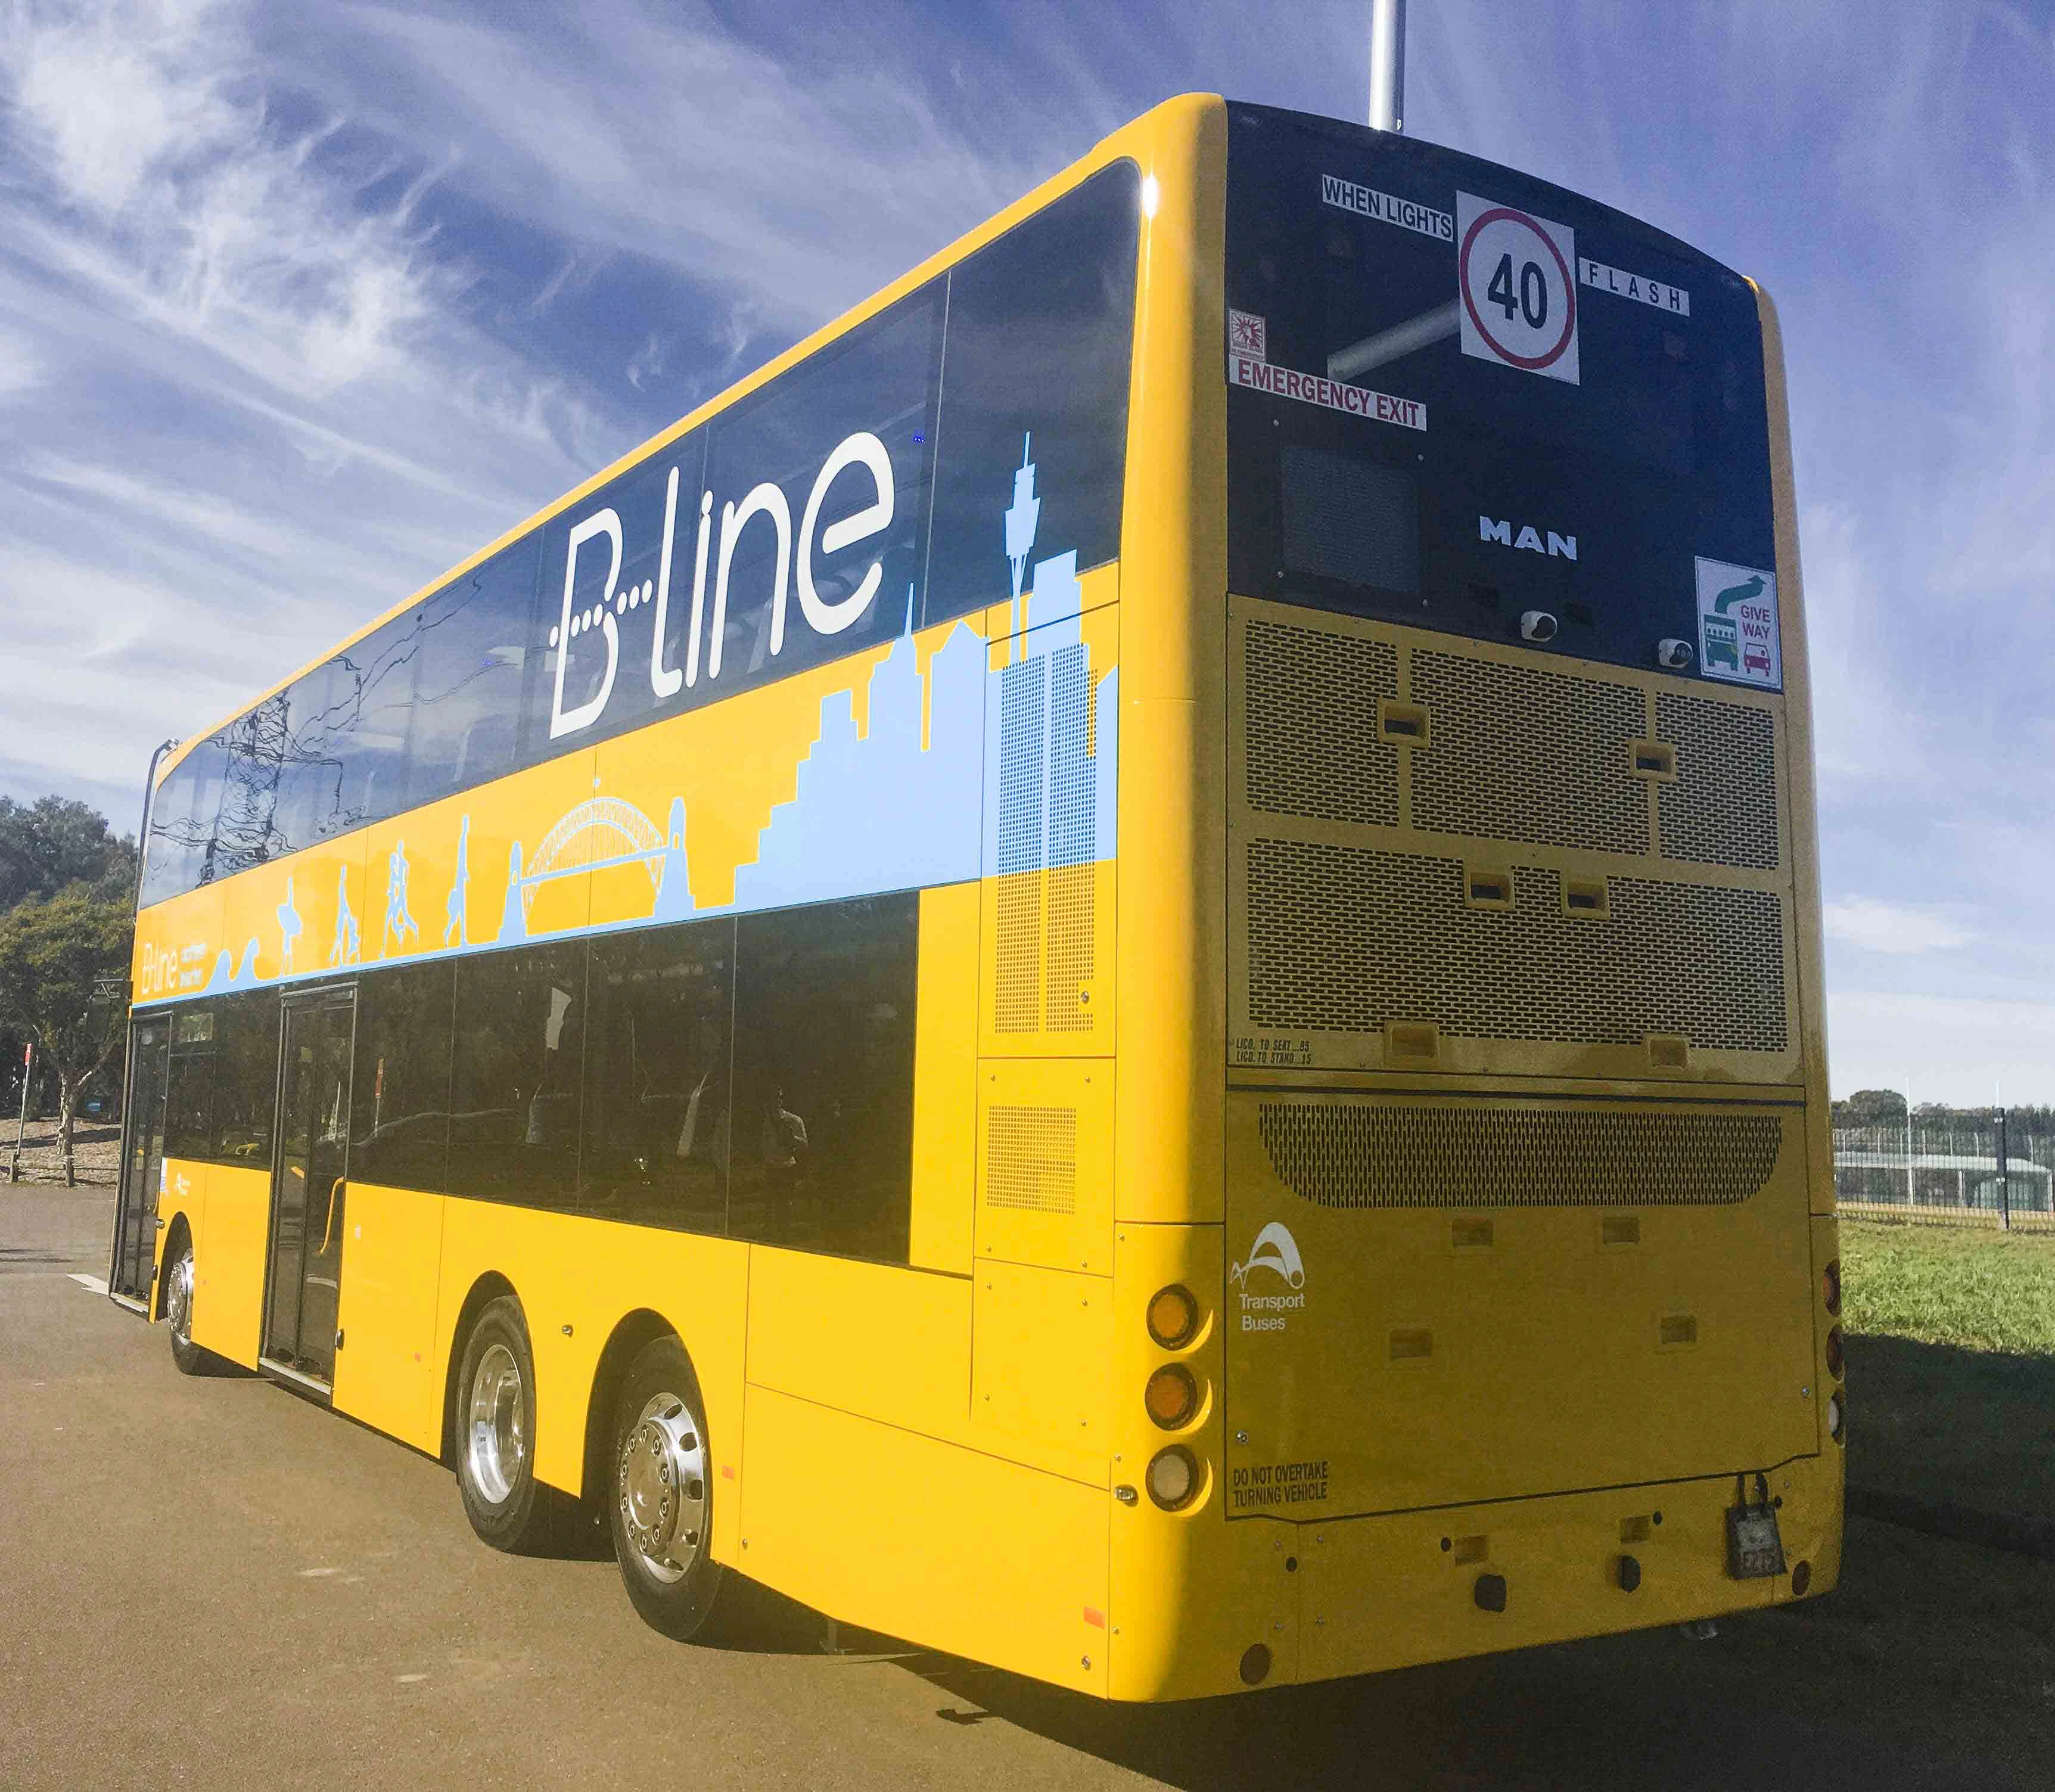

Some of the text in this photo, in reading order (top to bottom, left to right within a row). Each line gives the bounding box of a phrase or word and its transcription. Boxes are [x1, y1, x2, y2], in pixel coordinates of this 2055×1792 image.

[1324, 178, 1452, 238] WHEN LIGHTS
[1488, 253, 1547, 329] 40
[1588, 263, 1680, 311] FLASH
[1239, 359, 1419, 426] EMERGENCY EXIT
[1479, 515, 1578, 561] MAN
[1741, 605, 1771, 623] GIVE
[1742, 621, 1770, 639] WAY
[1258, 1051, 1267, 1063] TO
[1260, 1039, 1270, 1050] TO
[1239, 1293, 1305, 1312] Transport
[1242, 1315, 1286, 1330] Buses
[1233, 1460, 1328, 1487] DO NOT OVERTAKE
[1233, 1482, 1327, 1507] TURNING VEHICLE
